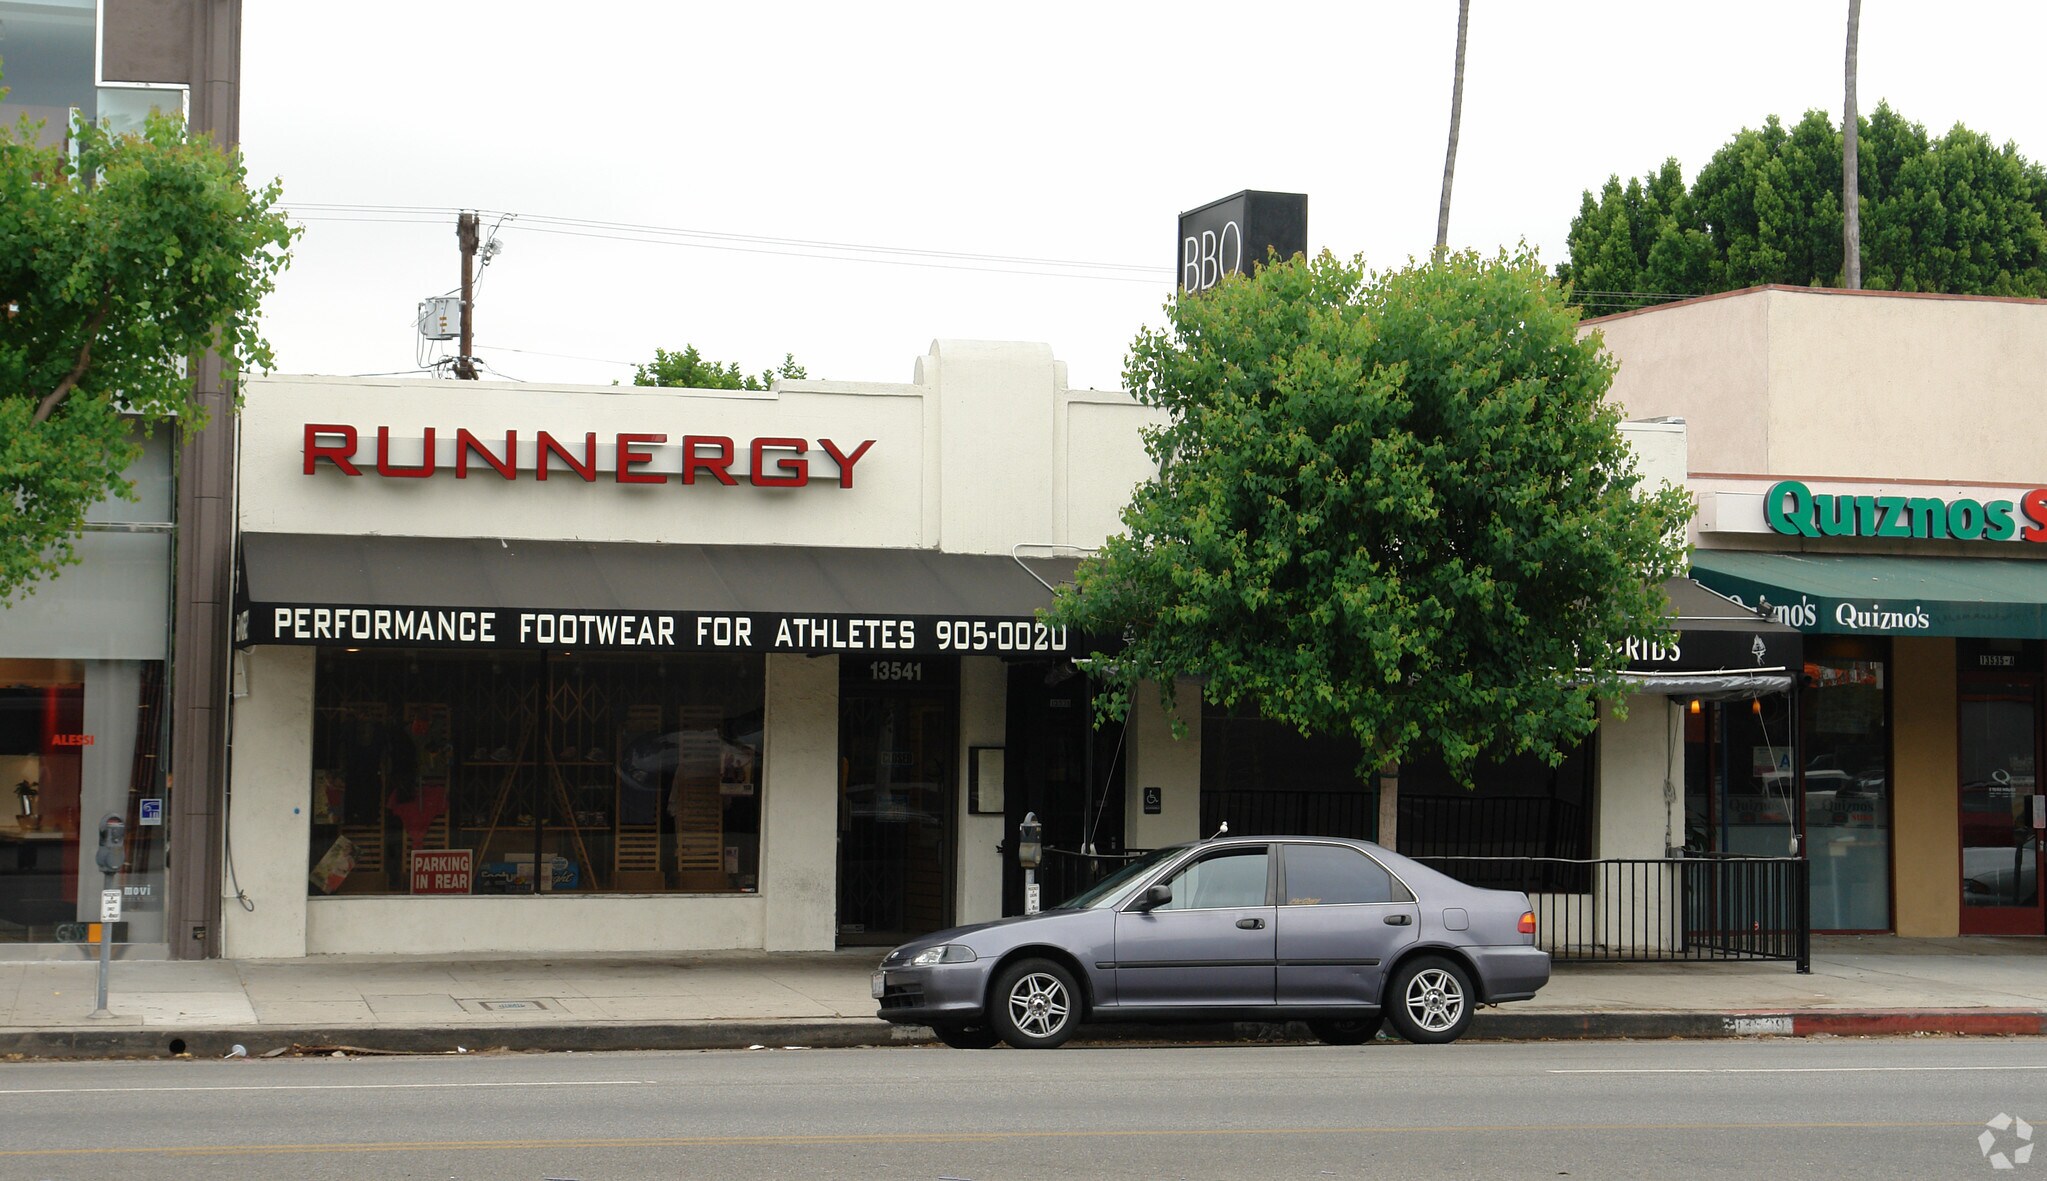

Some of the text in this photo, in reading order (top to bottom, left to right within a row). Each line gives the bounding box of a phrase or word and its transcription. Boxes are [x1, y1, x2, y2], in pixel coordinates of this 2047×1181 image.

[303, 423, 875, 488] RUNNERGY
[1766, 480, 2016, 541] Quiznos
[1835, 602, 1930, 630] Quizno's
[273, 608, 496, 644] PERFORMANCE
[520, 613, 675, 646] FOOTWEAR
[697, 616, 753, 647] FOR
[774, 618, 916, 649] ATHLETES
[936, 620, 1067, 651] 905-0020
[870, 661, 921, 680] 13541
[52, 735, 94, 746] ALESSI
[415, 855, 469, 872] PARKING
[124, 885, 151, 896] movi
[415, 874, 428, 889] IN
[435, 873, 467, 889] REAR
